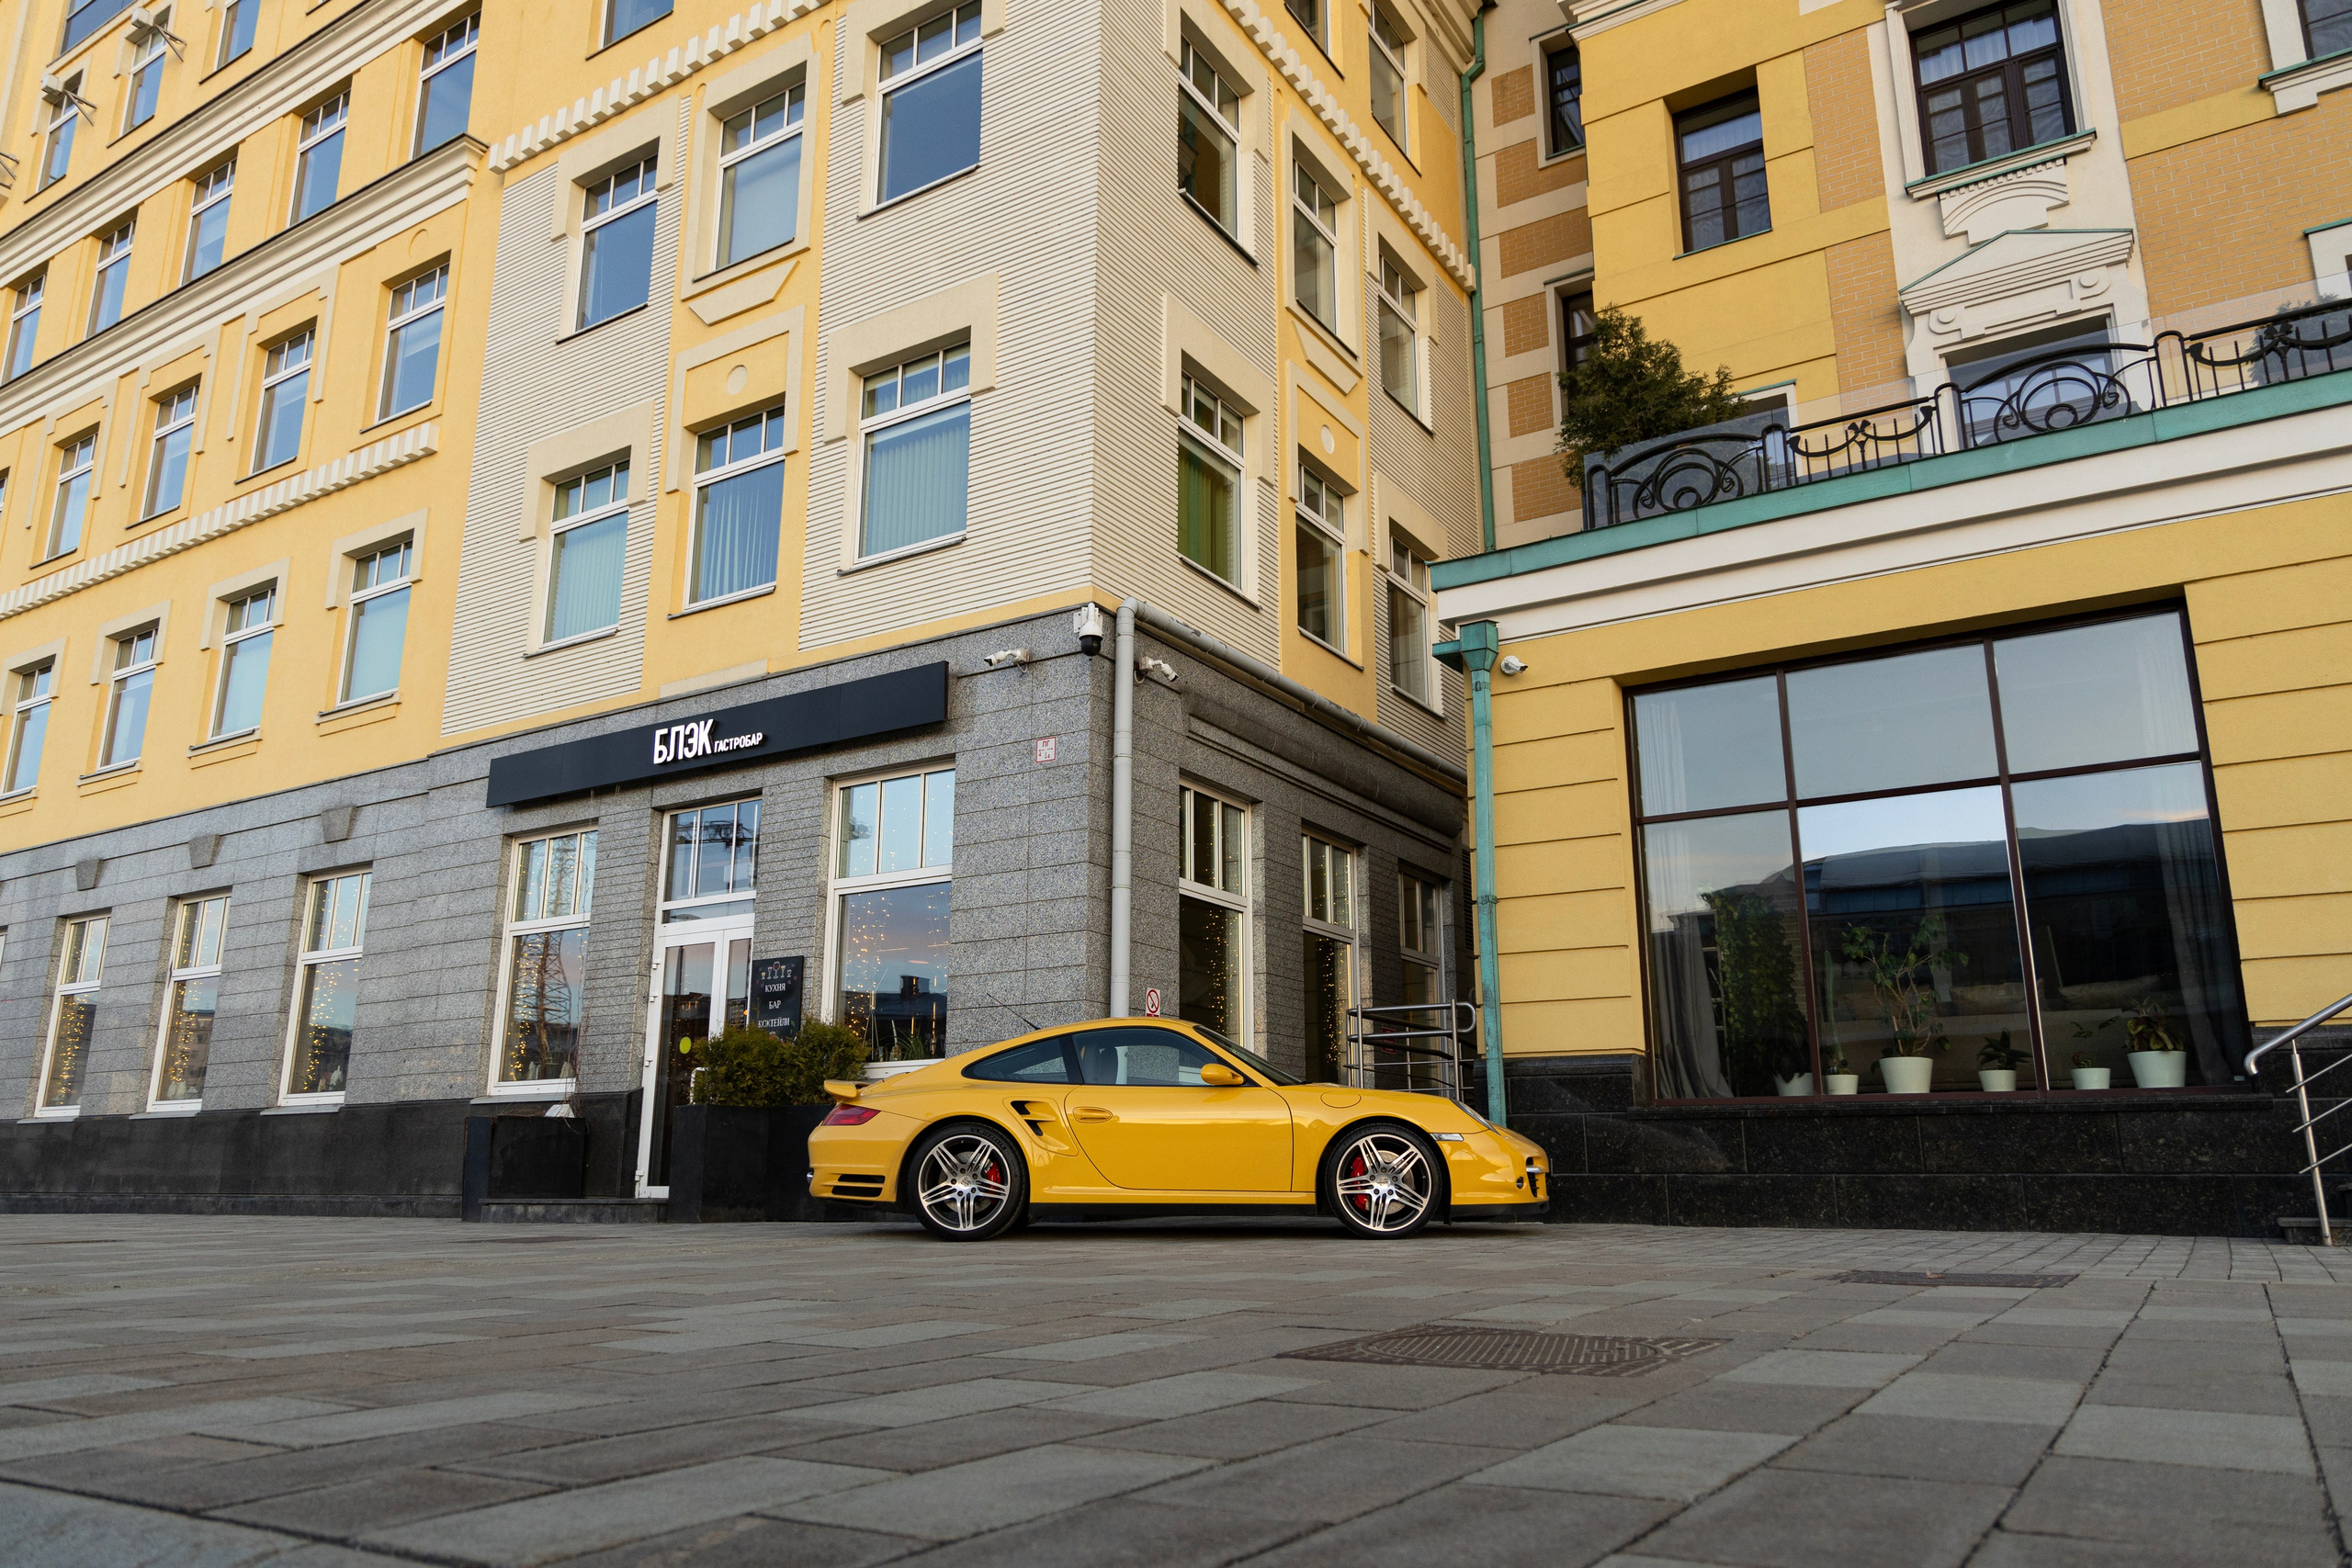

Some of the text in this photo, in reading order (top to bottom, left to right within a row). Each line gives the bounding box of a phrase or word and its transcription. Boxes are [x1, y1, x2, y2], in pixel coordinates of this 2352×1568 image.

[653, 718, 763, 764] БЛЭК ГАСТРОБАР
[764, 983, 786, 992] КУХНЯ
[768, 999, 782, 1010] БАР
[758, 1016, 790, 1028] КОКТЕЙЛИ
